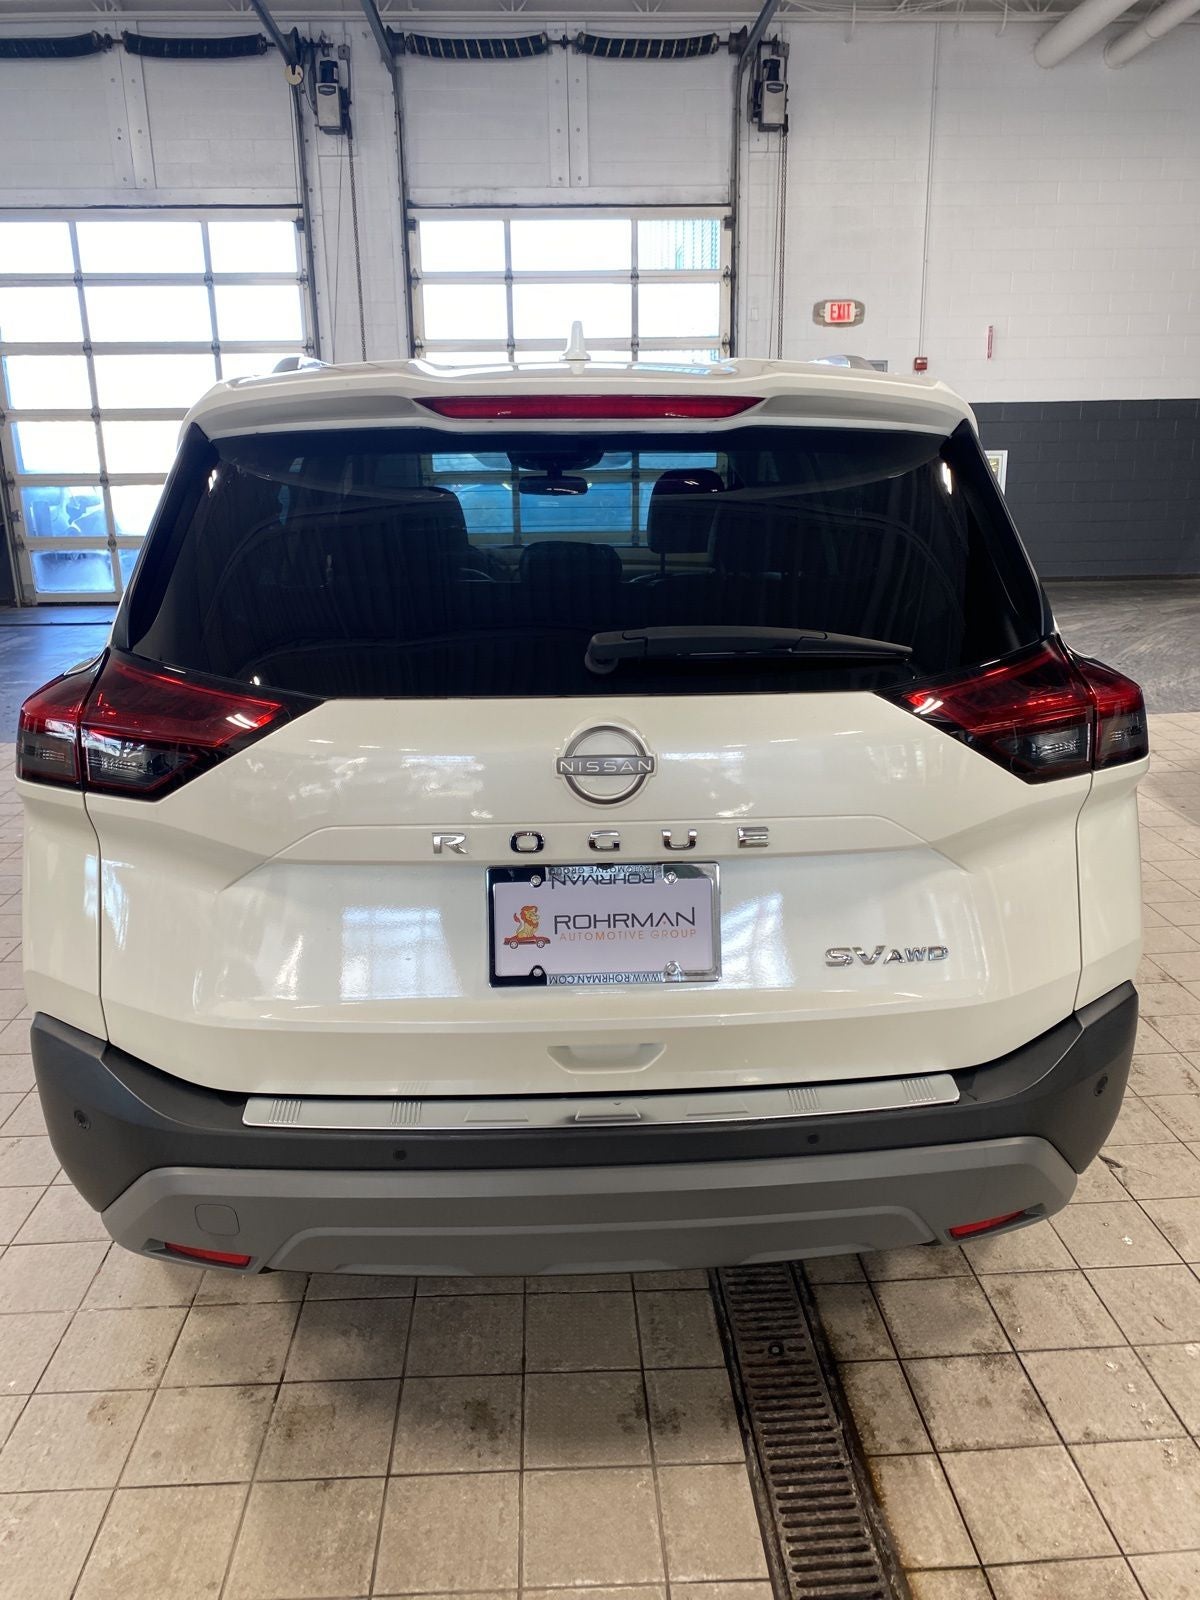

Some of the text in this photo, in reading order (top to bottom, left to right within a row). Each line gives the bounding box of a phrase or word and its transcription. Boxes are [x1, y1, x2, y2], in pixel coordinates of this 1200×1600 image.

[830, 303, 852, 321] EXIT
[560, 761, 651, 772] NISSAN
[432, 826, 769, 854] ROGUE
[548, 866, 584, 875] GROUP
[551, 870, 655, 890] ROHRMAN
[554, 907, 696, 935] ROHRMAN
[559, 928, 697, 942] AUTOMOTIVE GROUP
[549, 972, 662, 985] WWW.ROHRMAN.COM
